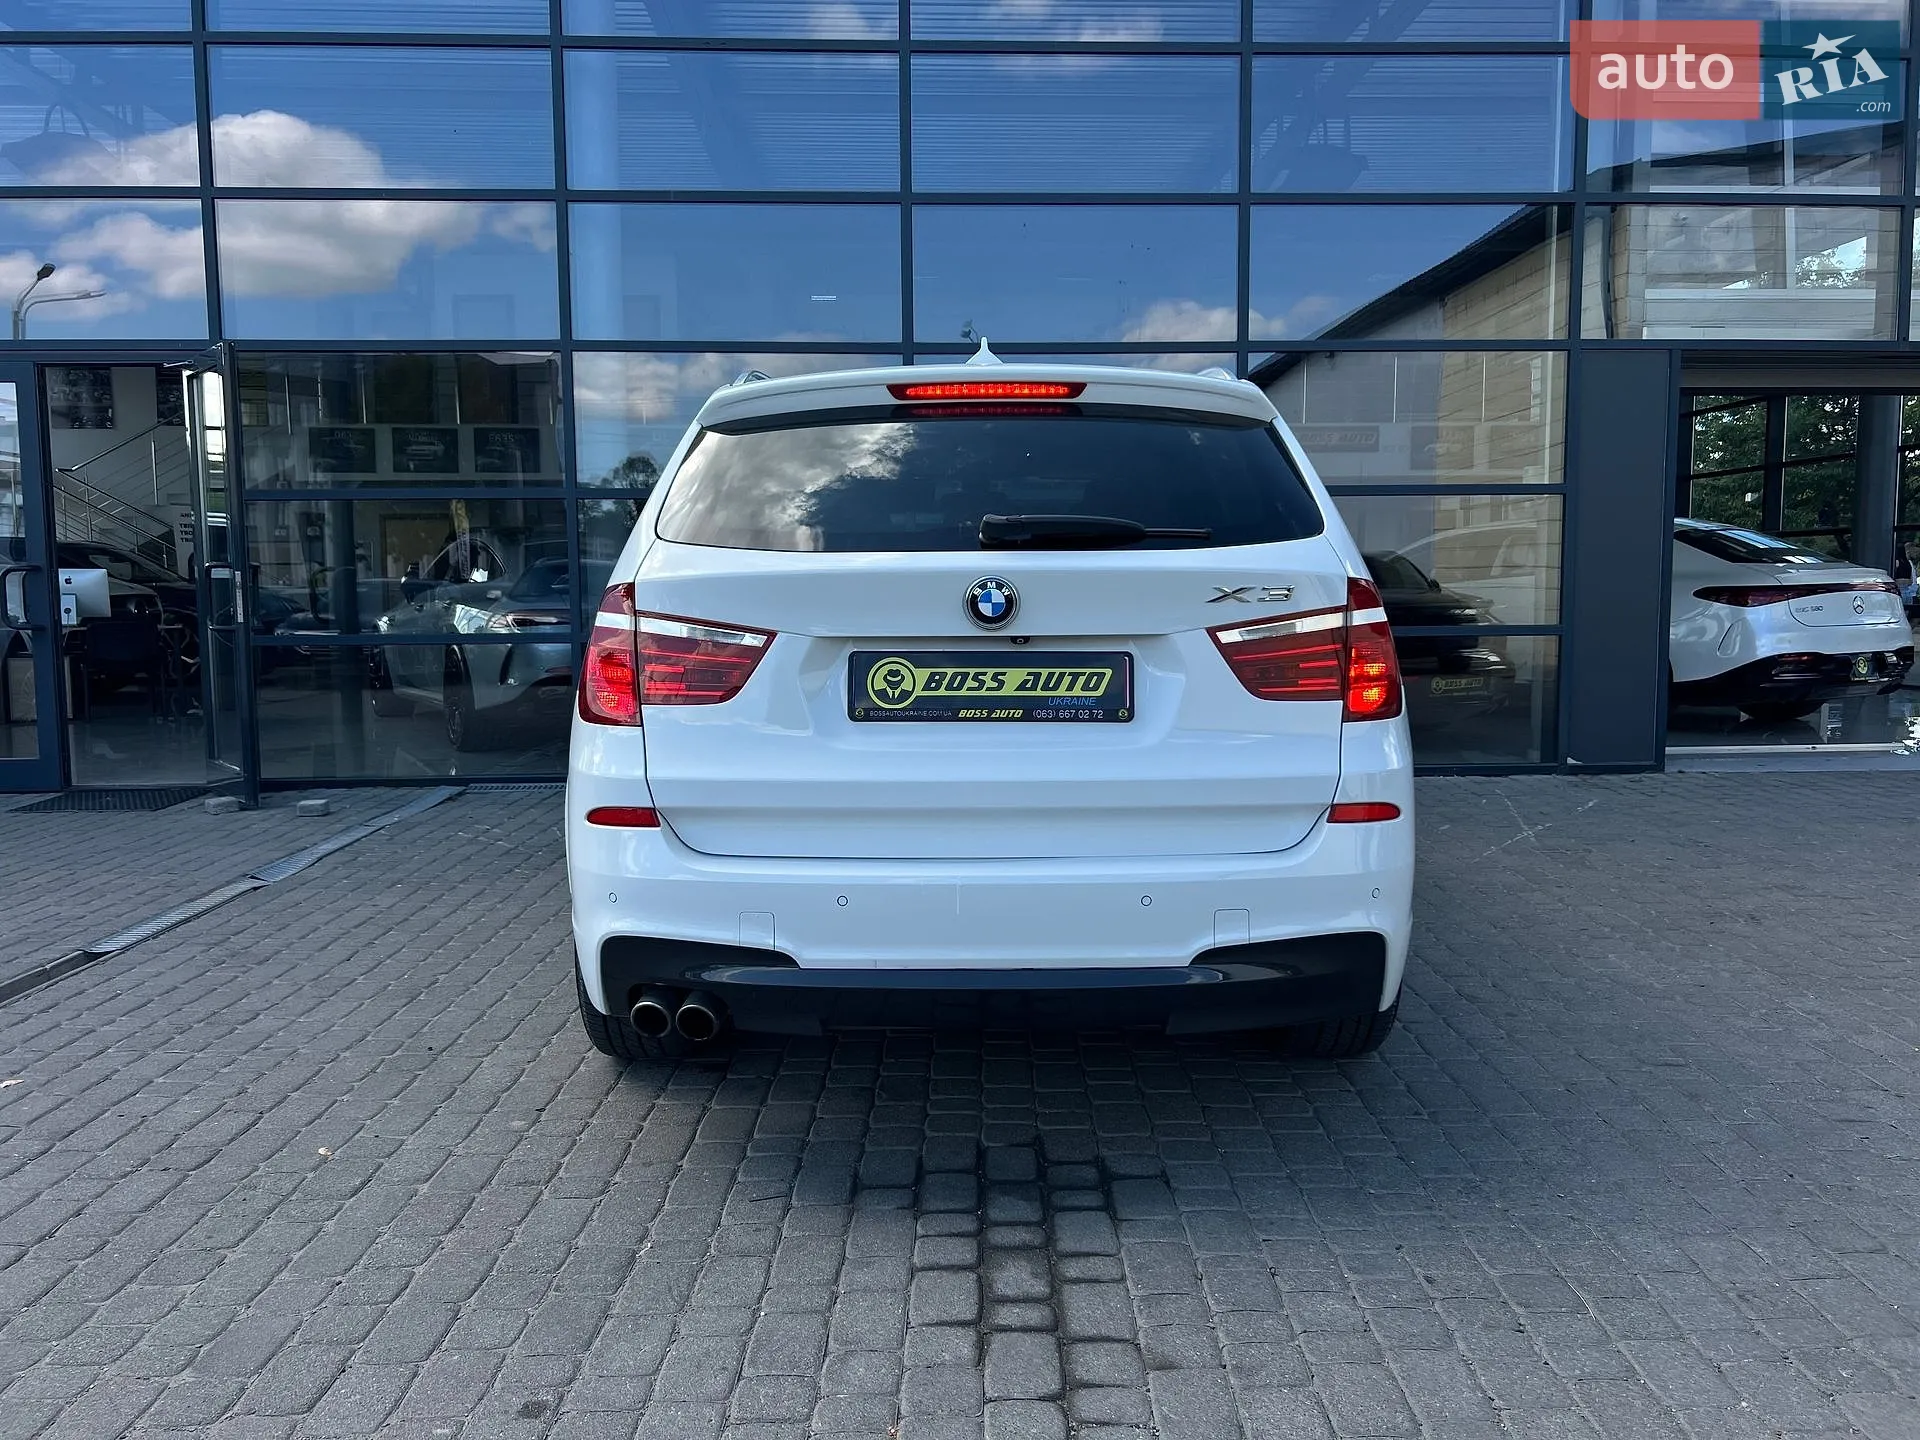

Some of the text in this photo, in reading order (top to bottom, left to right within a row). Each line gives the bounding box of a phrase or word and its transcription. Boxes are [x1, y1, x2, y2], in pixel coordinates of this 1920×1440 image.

[972, 581, 1011, 597] BMW
[1205, 584, 1295, 603] X3
[921, 671, 1108, 693] BOSS AUTO
[1047, 697, 1097, 706] UKRAINE
[958, 709, 1024, 718] BOSS AUTO
[1032, 709, 1104, 719] (063) 667 02 72
